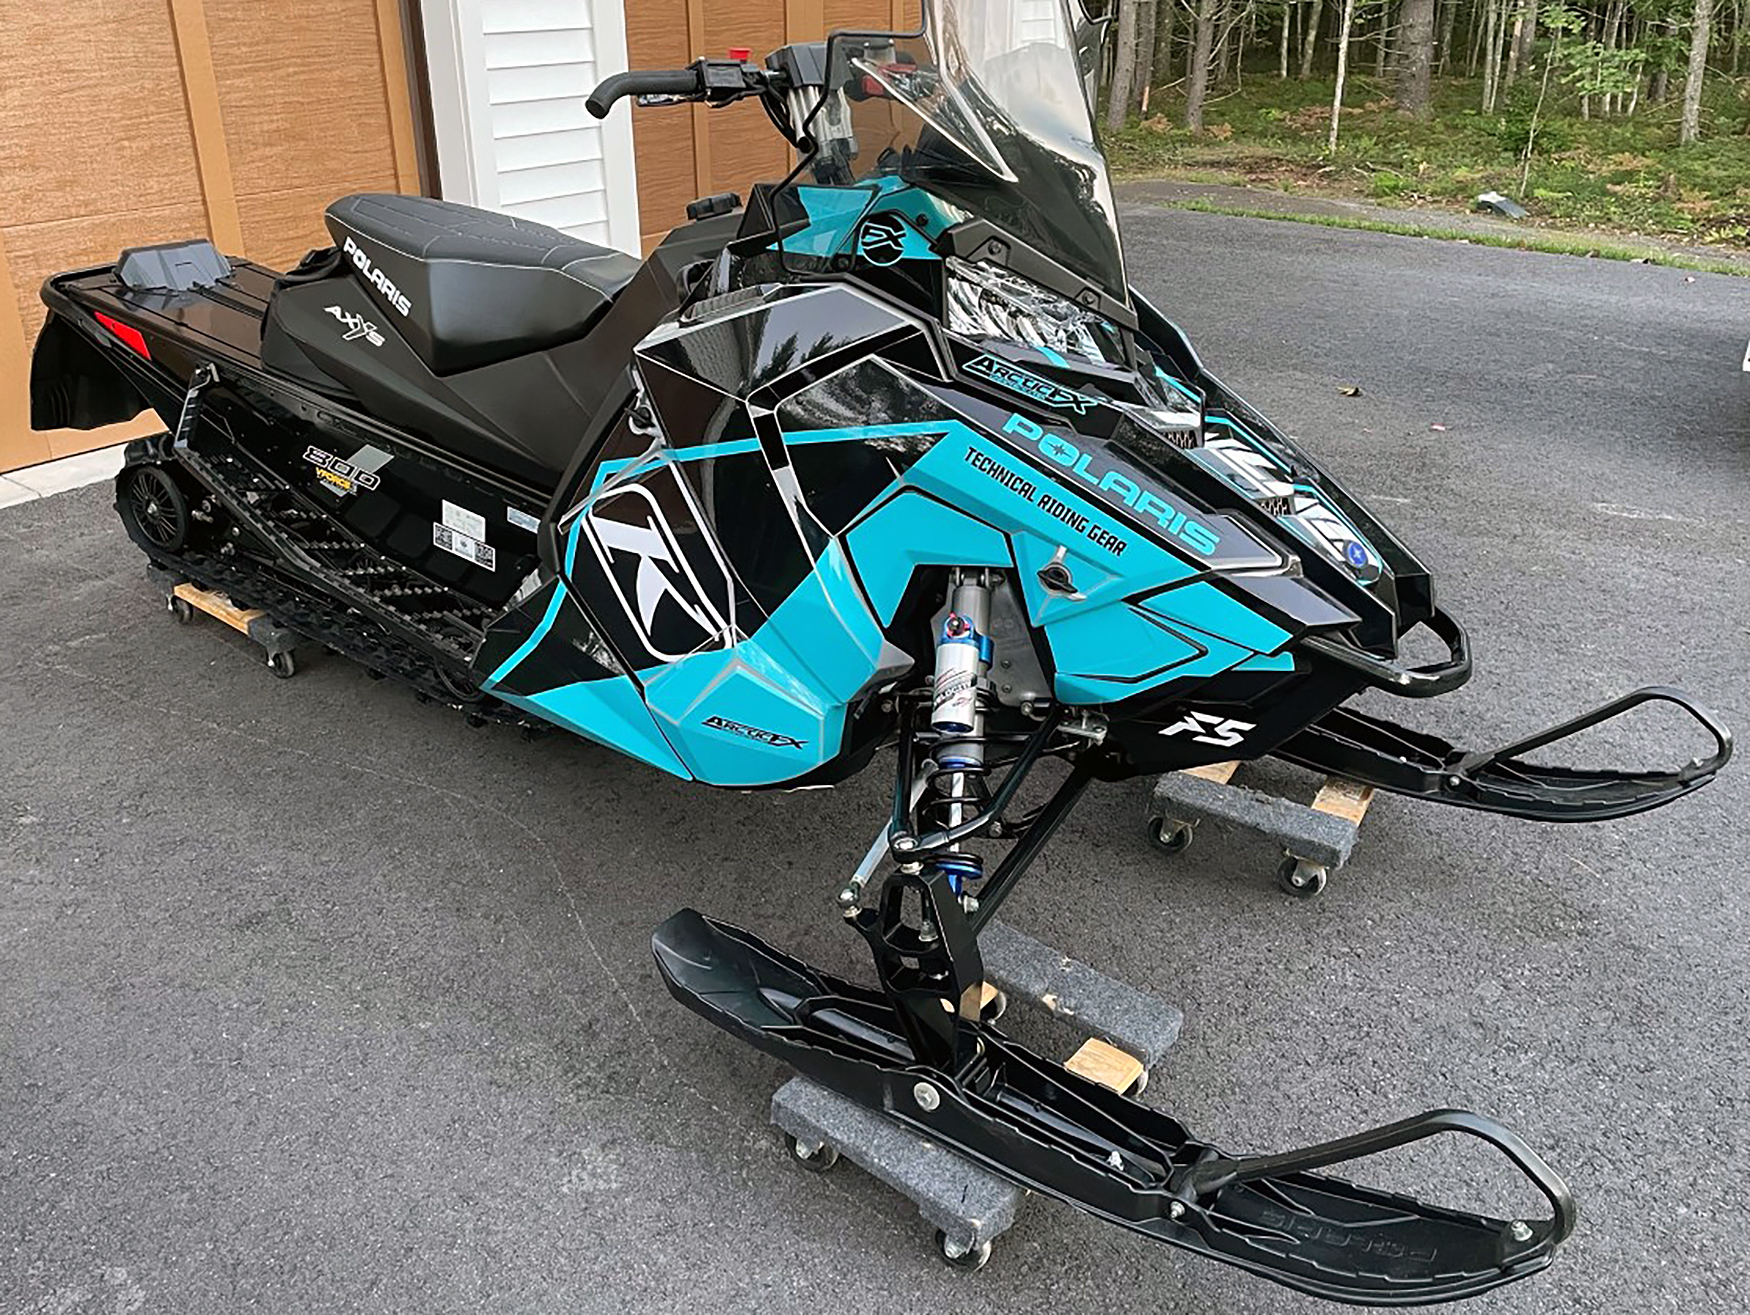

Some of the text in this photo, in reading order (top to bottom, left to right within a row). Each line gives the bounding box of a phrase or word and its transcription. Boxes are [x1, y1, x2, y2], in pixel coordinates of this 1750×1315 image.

[343, 236, 412, 317] POLARIS
[303, 445, 381, 492] 800
[964, 446, 1128, 557] TECHNICAL RIDING GEAR
[1003, 412, 1220, 556] POLARIS
